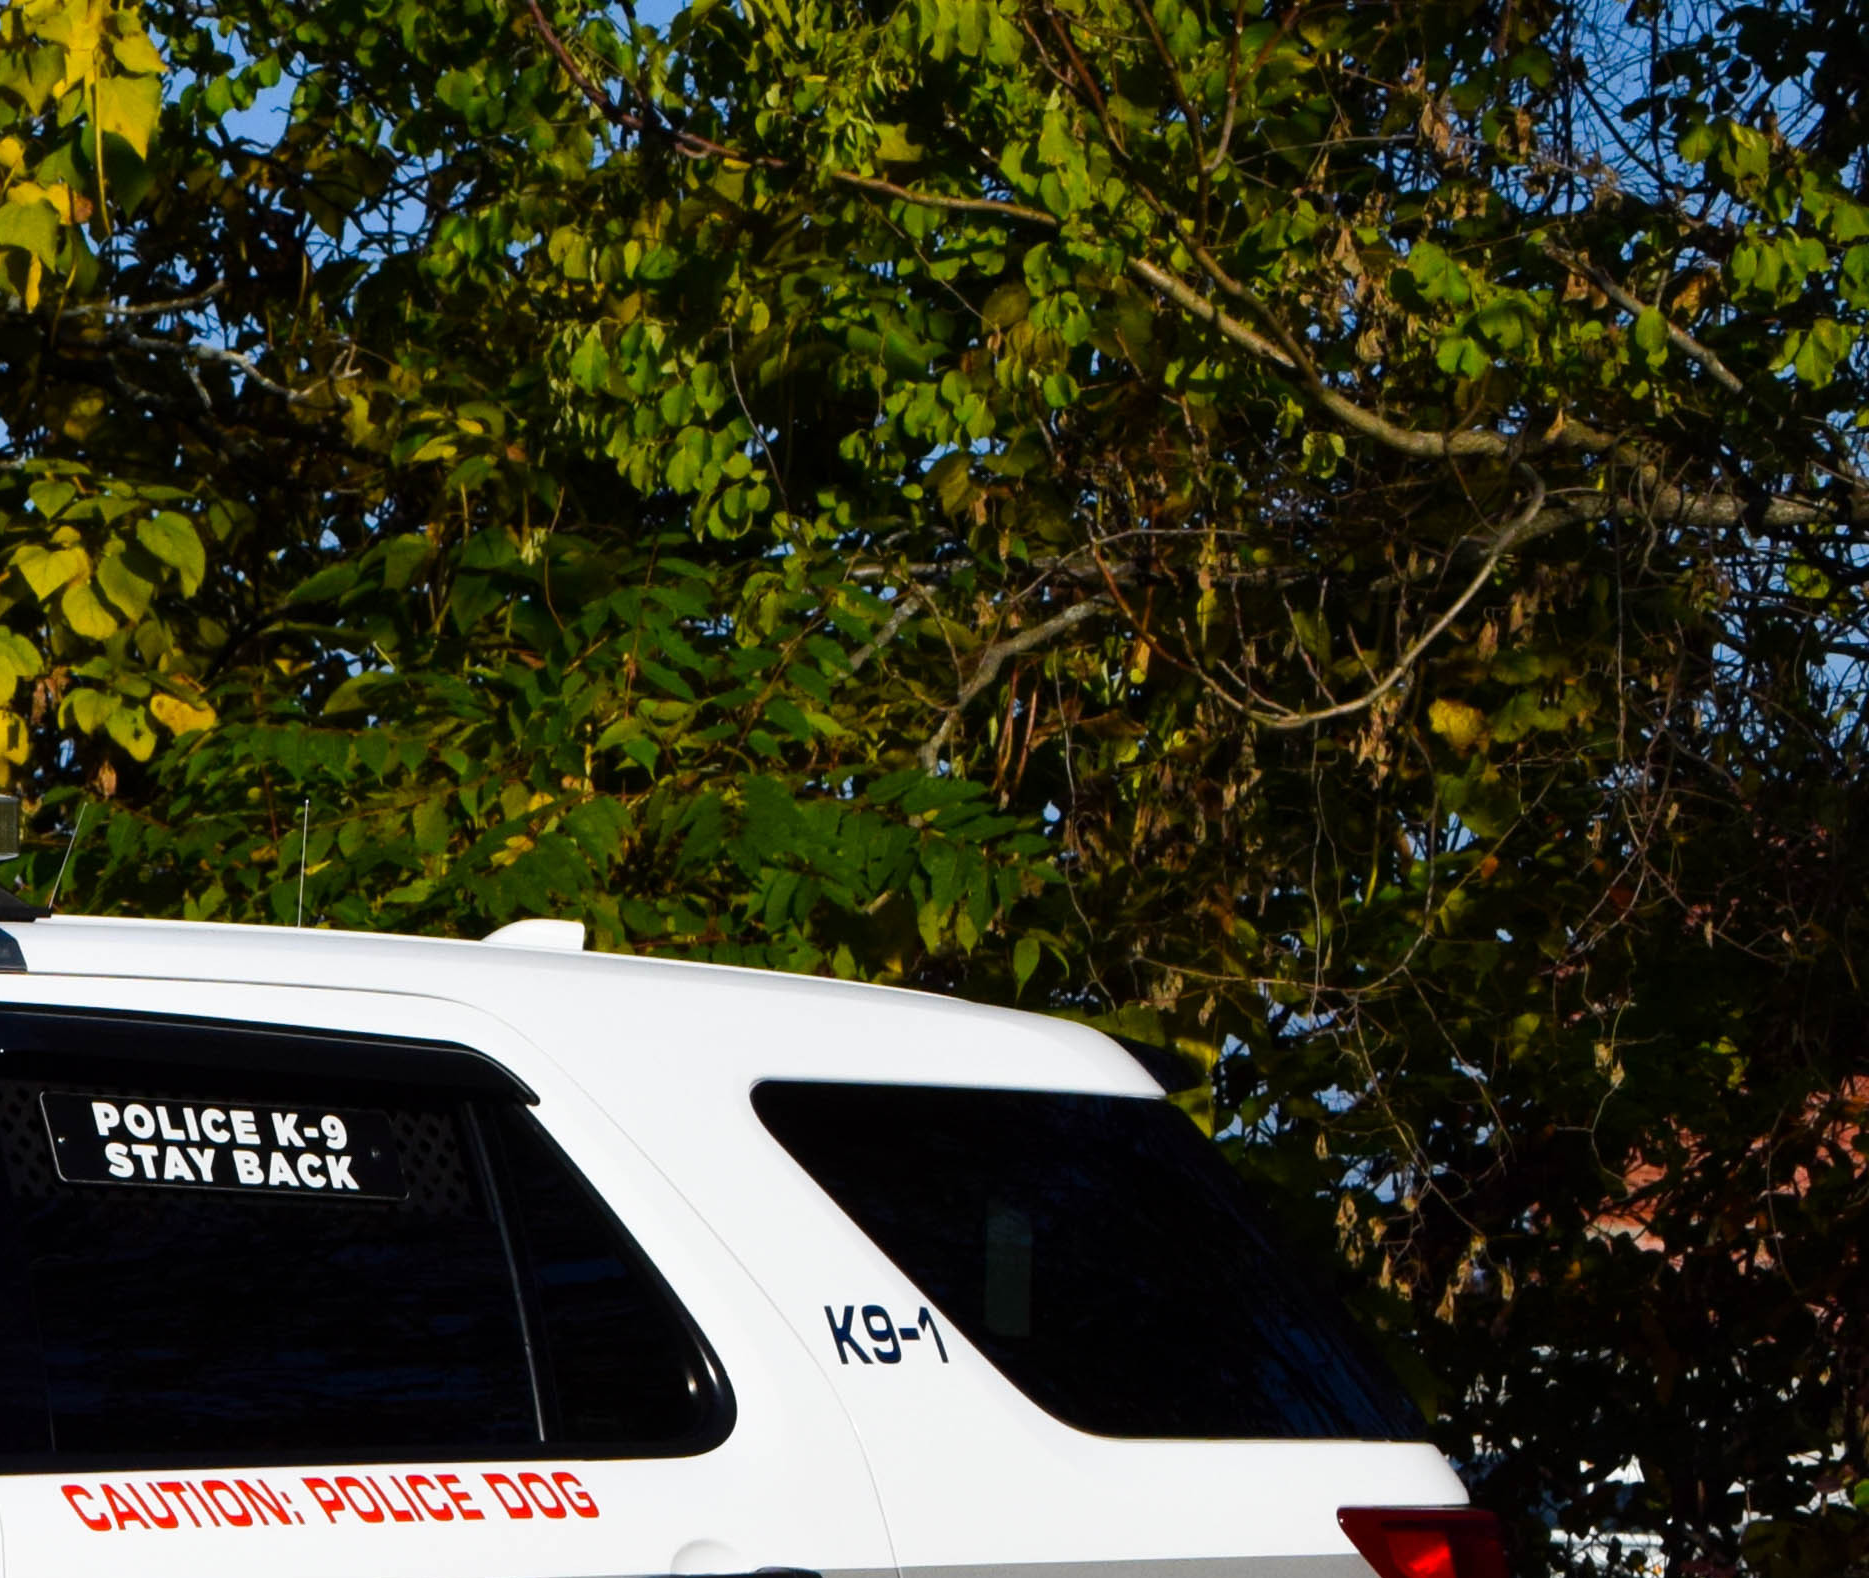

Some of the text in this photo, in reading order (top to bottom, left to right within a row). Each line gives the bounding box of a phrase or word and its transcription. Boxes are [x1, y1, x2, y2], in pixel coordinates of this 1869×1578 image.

[91, 1101, 348, 1151] POLICE K-9
[103, 1142, 361, 1191] STAY BACK
[823, 1304, 950, 1365] K9-1
[60, 1470, 602, 1533] CAUTION: POLICE DOG
